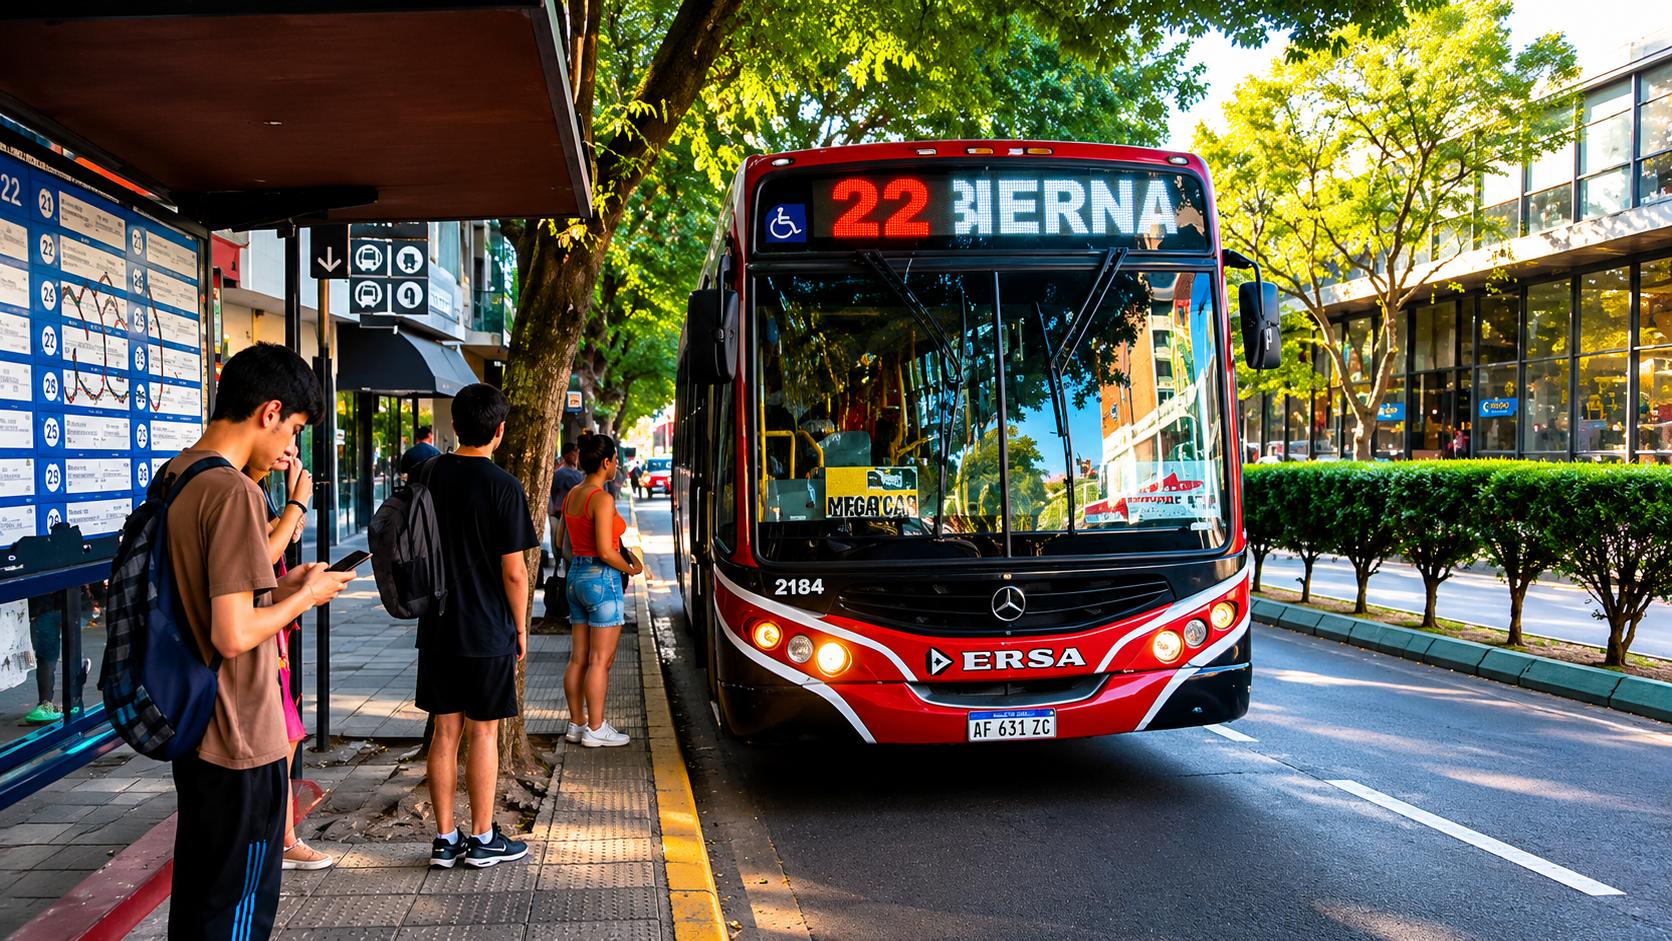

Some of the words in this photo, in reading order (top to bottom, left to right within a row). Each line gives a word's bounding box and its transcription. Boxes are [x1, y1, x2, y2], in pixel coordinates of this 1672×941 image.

[1, 173, 22, 207] 22
[41, 193, 52, 213] 21
[832, 178, 930, 237] 22
[42, 239, 53, 257] 22
[47, 469, 59, 485] 28
[774, 578, 825, 596] 2184
[961, 647, 1087, 671] ERSA
[973, 721, 992, 738] AF
[998, 719, 1026, 737] 631
[1032, 718, 1051, 736] ZC
